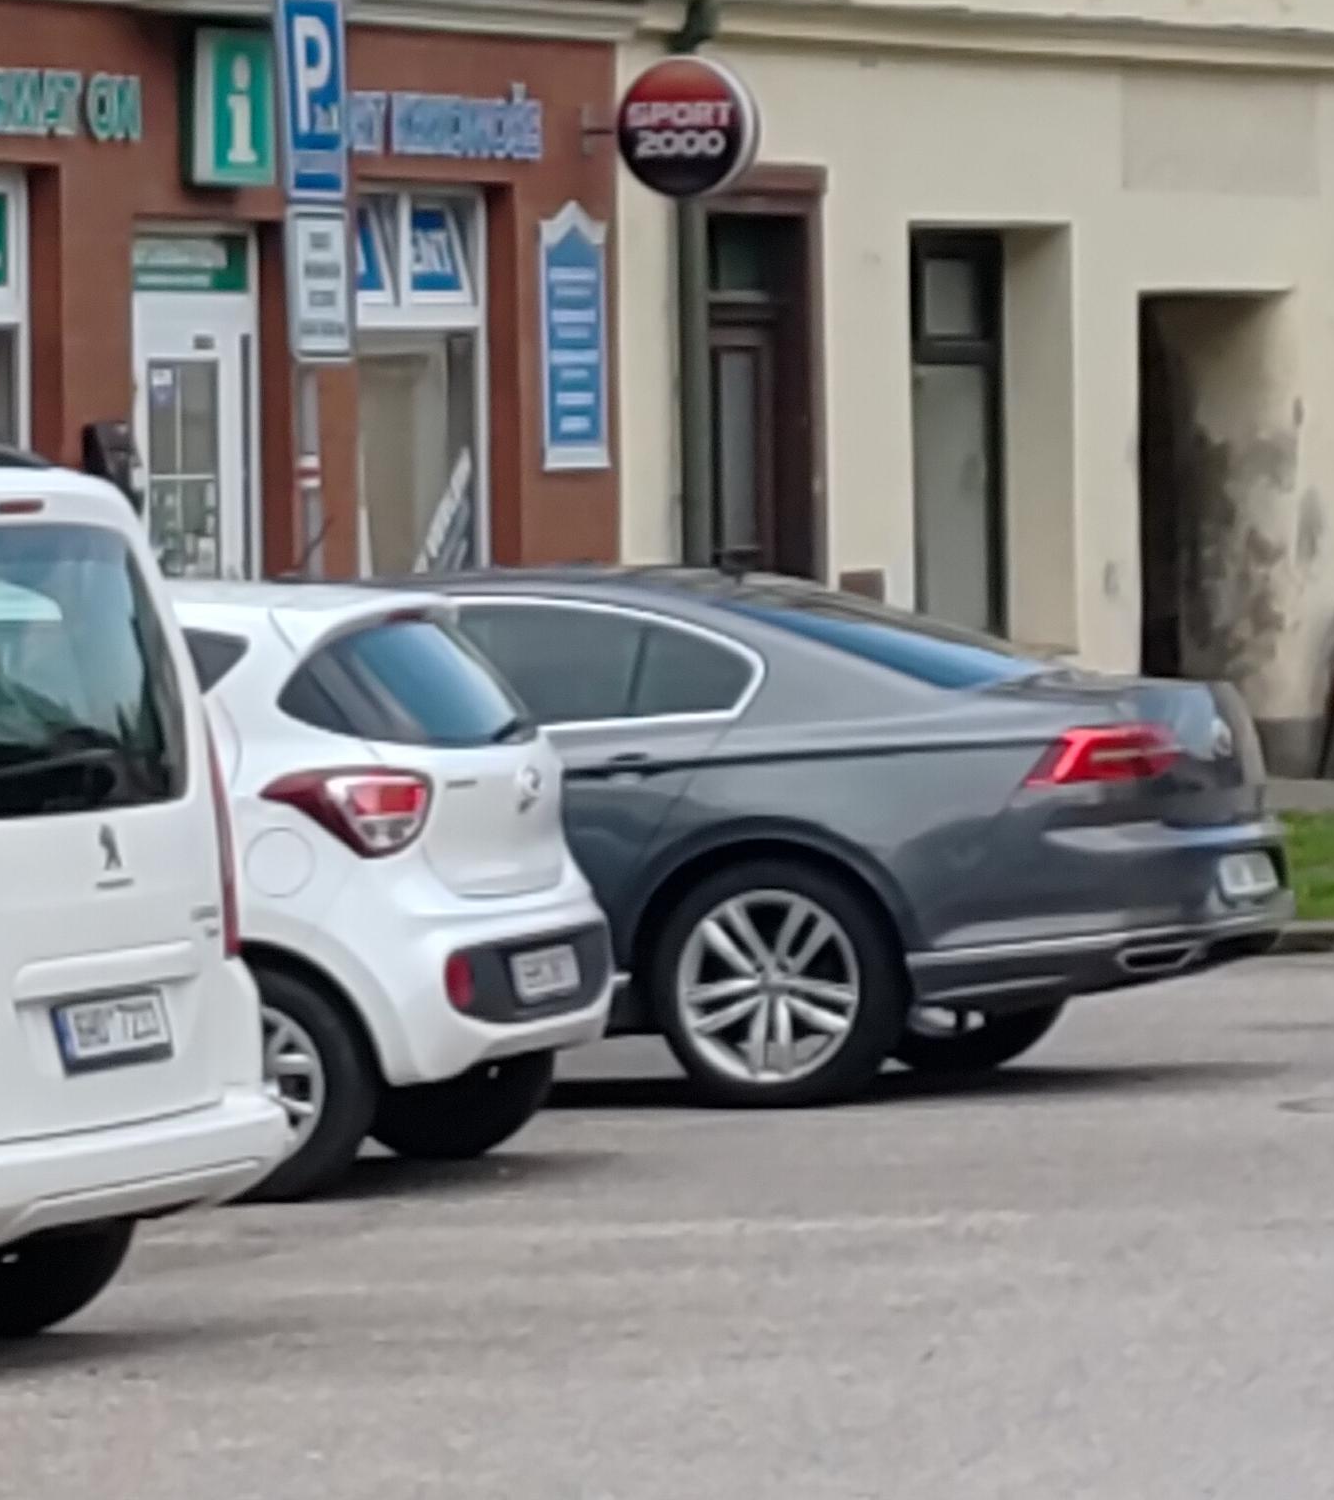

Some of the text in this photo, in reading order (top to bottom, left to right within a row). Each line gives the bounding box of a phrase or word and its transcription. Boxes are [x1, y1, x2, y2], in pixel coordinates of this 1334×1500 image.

[293, 14, 331, 134] P
[626, 100, 732, 128] SPORT
[635, 128, 727, 158] 2000
